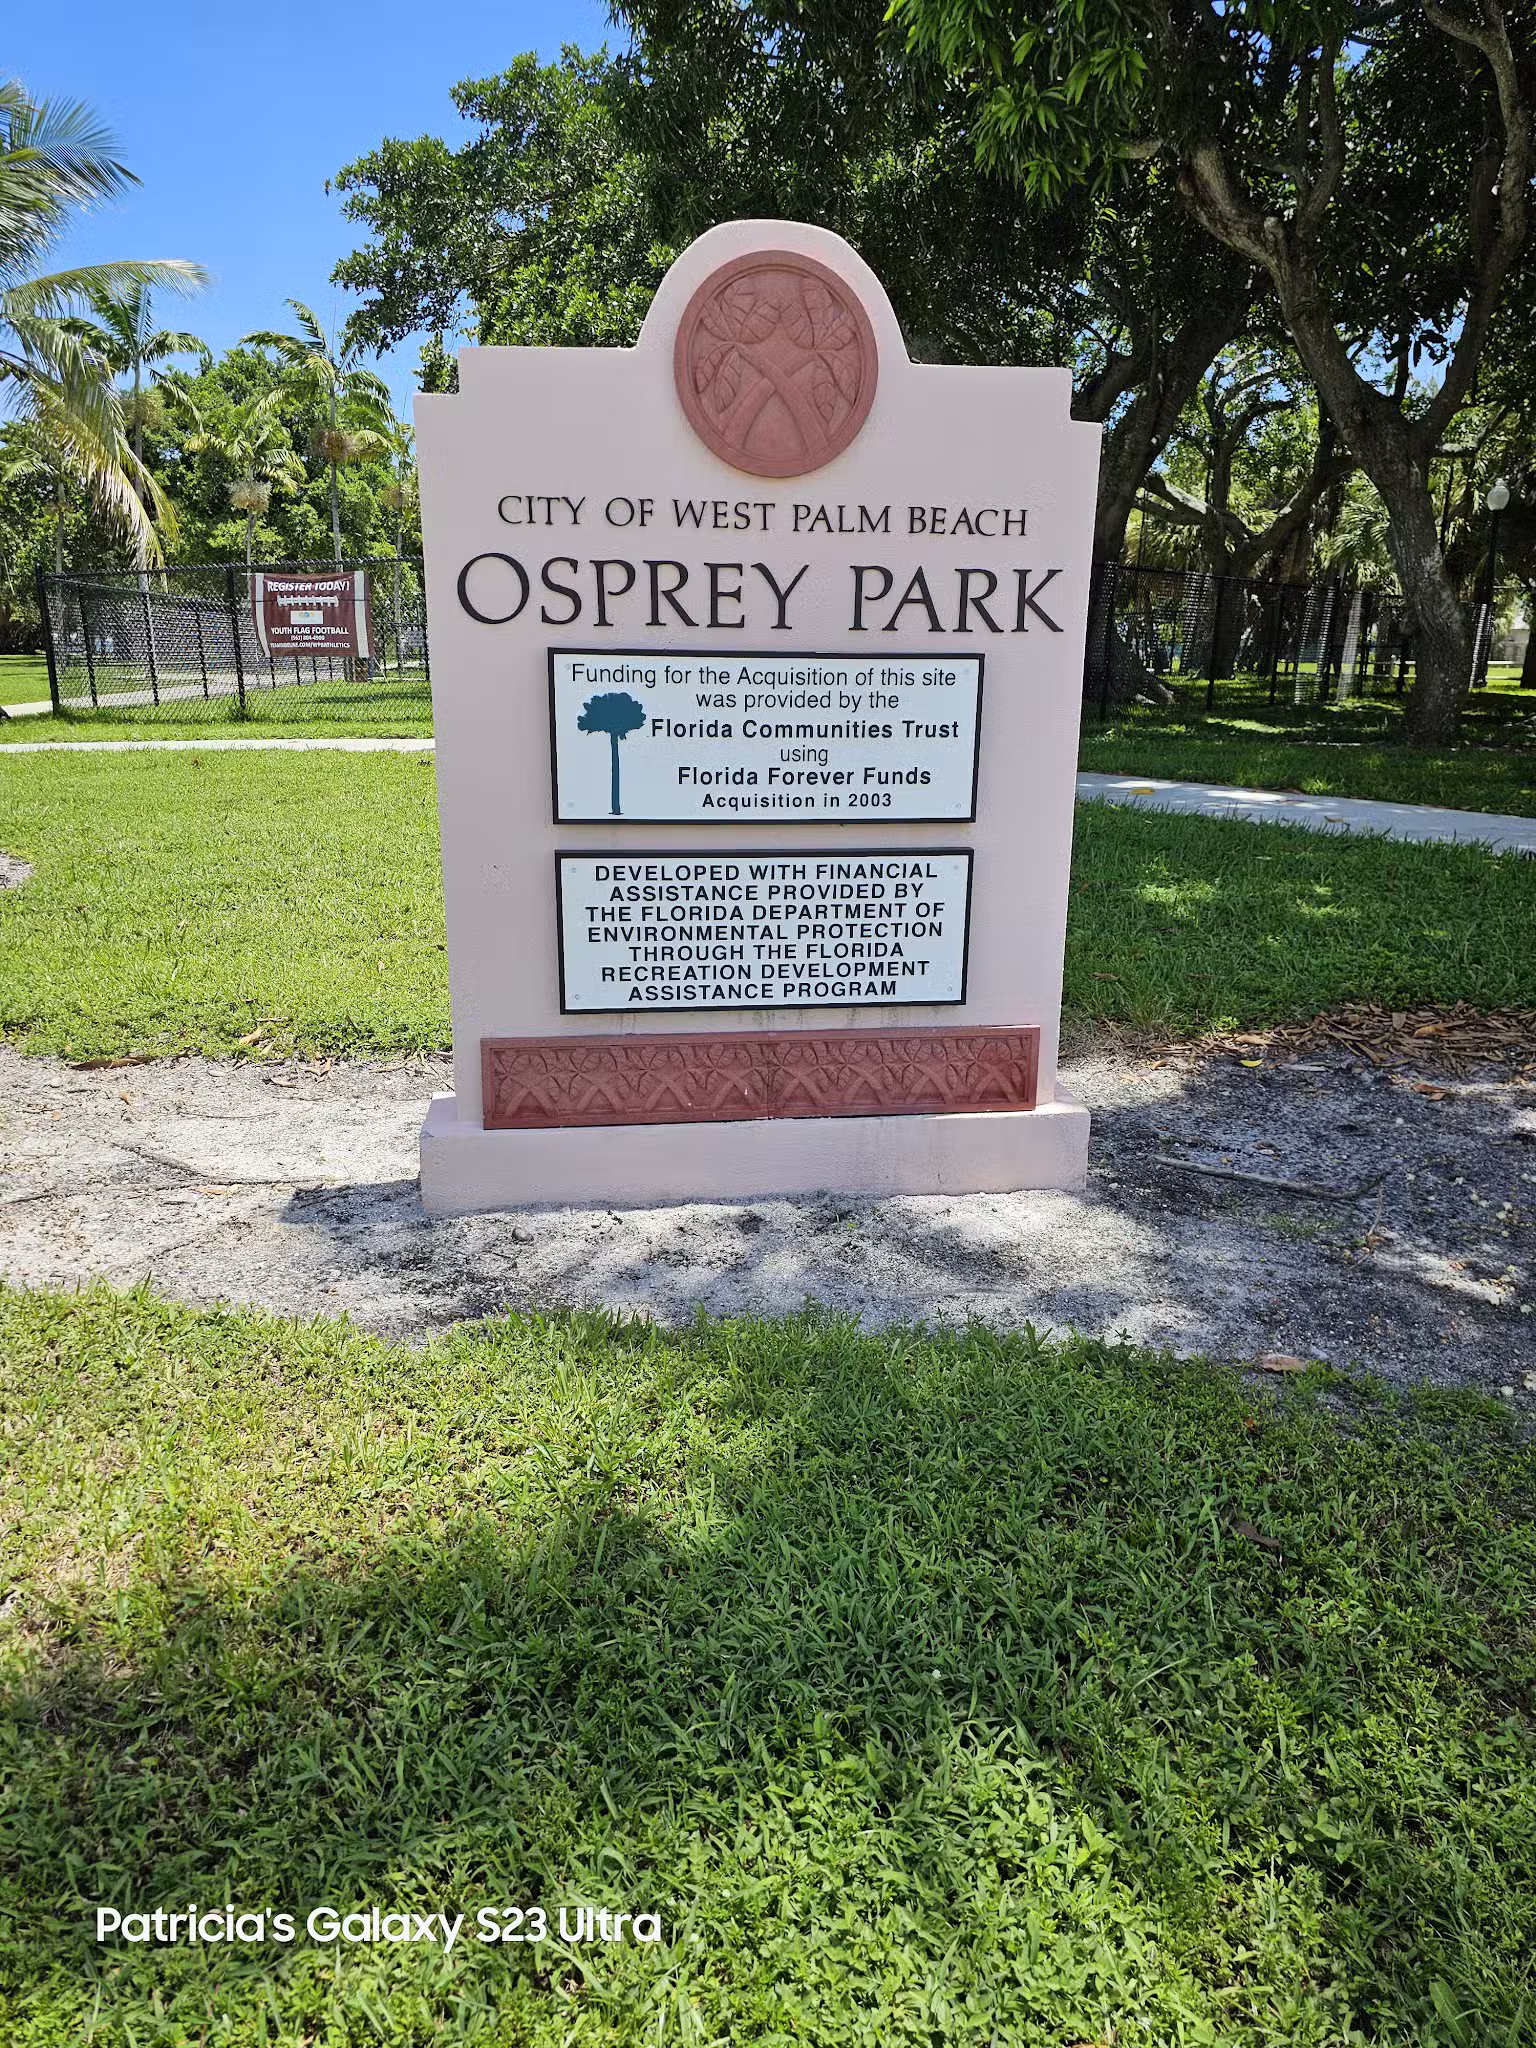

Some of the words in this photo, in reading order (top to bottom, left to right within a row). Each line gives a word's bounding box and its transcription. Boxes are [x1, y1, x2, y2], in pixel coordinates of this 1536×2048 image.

[498, 496, 585, 525] CITY
[606, 498, 653, 526] OF
[673, 500, 775, 530] WEST
[793, 505, 891, 532] PALM
[908, 507, 1027, 536] BEACH
[267, 581, 314, 592] REGISTER
[314, 581, 350, 591] TODAY!
[457, 553, 809, 629] OSPREY
[849, 566, 1064, 633] PARK
[271, 627, 292, 635] YOUTH
[293, 627, 311, 635] FLAG
[311, 627, 349, 635] FOOTBALL
[573, 664, 655, 688] Funding
[665, 666, 691, 683] for
[699, 666, 730, 684] the
[737, 667, 847, 693] Acquisition
[856, 668, 873, 685] of
[881, 668, 914, 685] this
[923, 668, 955, 685] site
[696, 694, 736, 707] was
[745, 690, 830, 712] provided
[840, 691, 861, 712] by
[869, 691, 898, 708] the
[652, 719, 732, 737] Florida
[743, 720, 892, 738] Communities
[902, 721, 958, 737] Trust
[781, 745, 828, 766] using
[679, 767, 757, 785] Florida
[769, 768, 854, 785] Forever
[864, 767, 930, 784] Funds
[702, 794, 814, 811] Acquisition
[824, 793, 839, 807] in
[849, 793, 891, 807] 2003
[596, 866, 739, 881] DEVELOPED
[749, 865, 805, 879] WITH
[817, 863, 937, 879] FINANCIAL
[610, 886, 757, 901] ASSISTANCE
[769, 884, 884, 899] PROVIDED
[895, 883, 923, 898] BY
[586, 907, 631, 921] THE
[642, 906, 743, 921] FLORIDA
[753, 903, 906, 920] DEPARTMENT
[916, 903, 944, 917] OF
[589, 925, 787, 942] ENVIRONMENTAL
[798, 922, 942, 939] PROTECTION
[629, 945, 743, 961] THROUGH
[753, 944, 796, 959] THE
[807, 943, 903, 958] FLORIDA
[602, 965, 750, 981] RECREATION
[762, 961, 929, 978] DEVELOPMENT
[629, 984, 773, 1001] ASSISTANCE
[784, 981, 896, 997] PROGRAM
